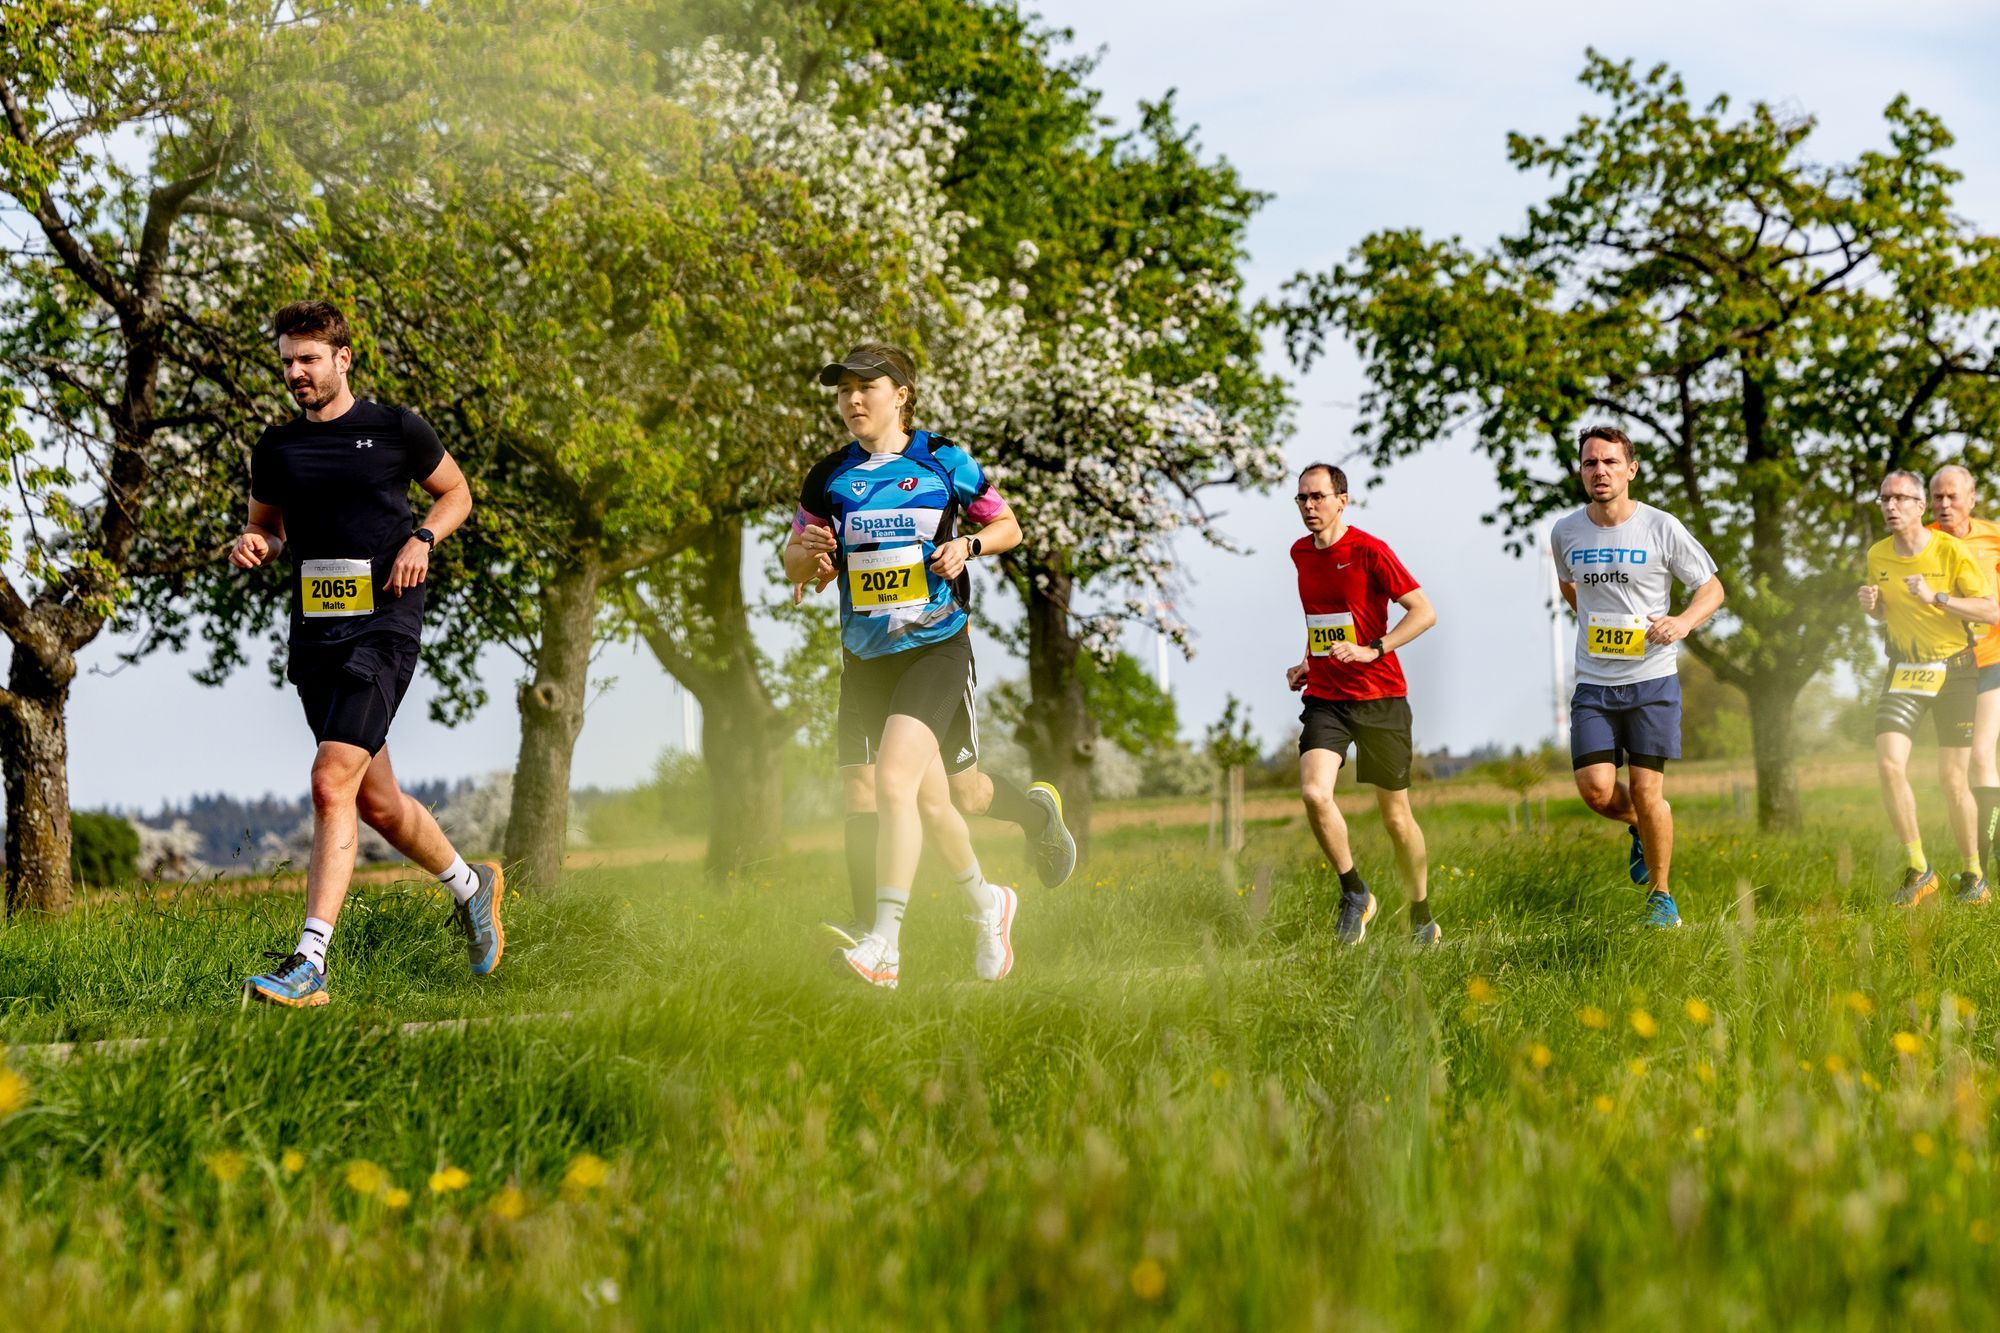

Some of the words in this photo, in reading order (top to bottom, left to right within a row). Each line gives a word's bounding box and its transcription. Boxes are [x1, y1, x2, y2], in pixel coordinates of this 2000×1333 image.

[851, 513, 916, 533] Sparda
[1571, 548, 1647, 565] FESTO
[861, 568, 911, 592] 2027
[1583, 570, 1629, 587] sports
[311, 579, 358, 599] 2065
[322, 601, 346, 610] Malte
[877, 593, 898, 603] Nina
[1314, 627, 1346, 643] 2108
[1596, 628, 1634, 645] 2187
[1601, 646, 1625, 654] Marcel
[1902, 670, 1935, 683] 2122
